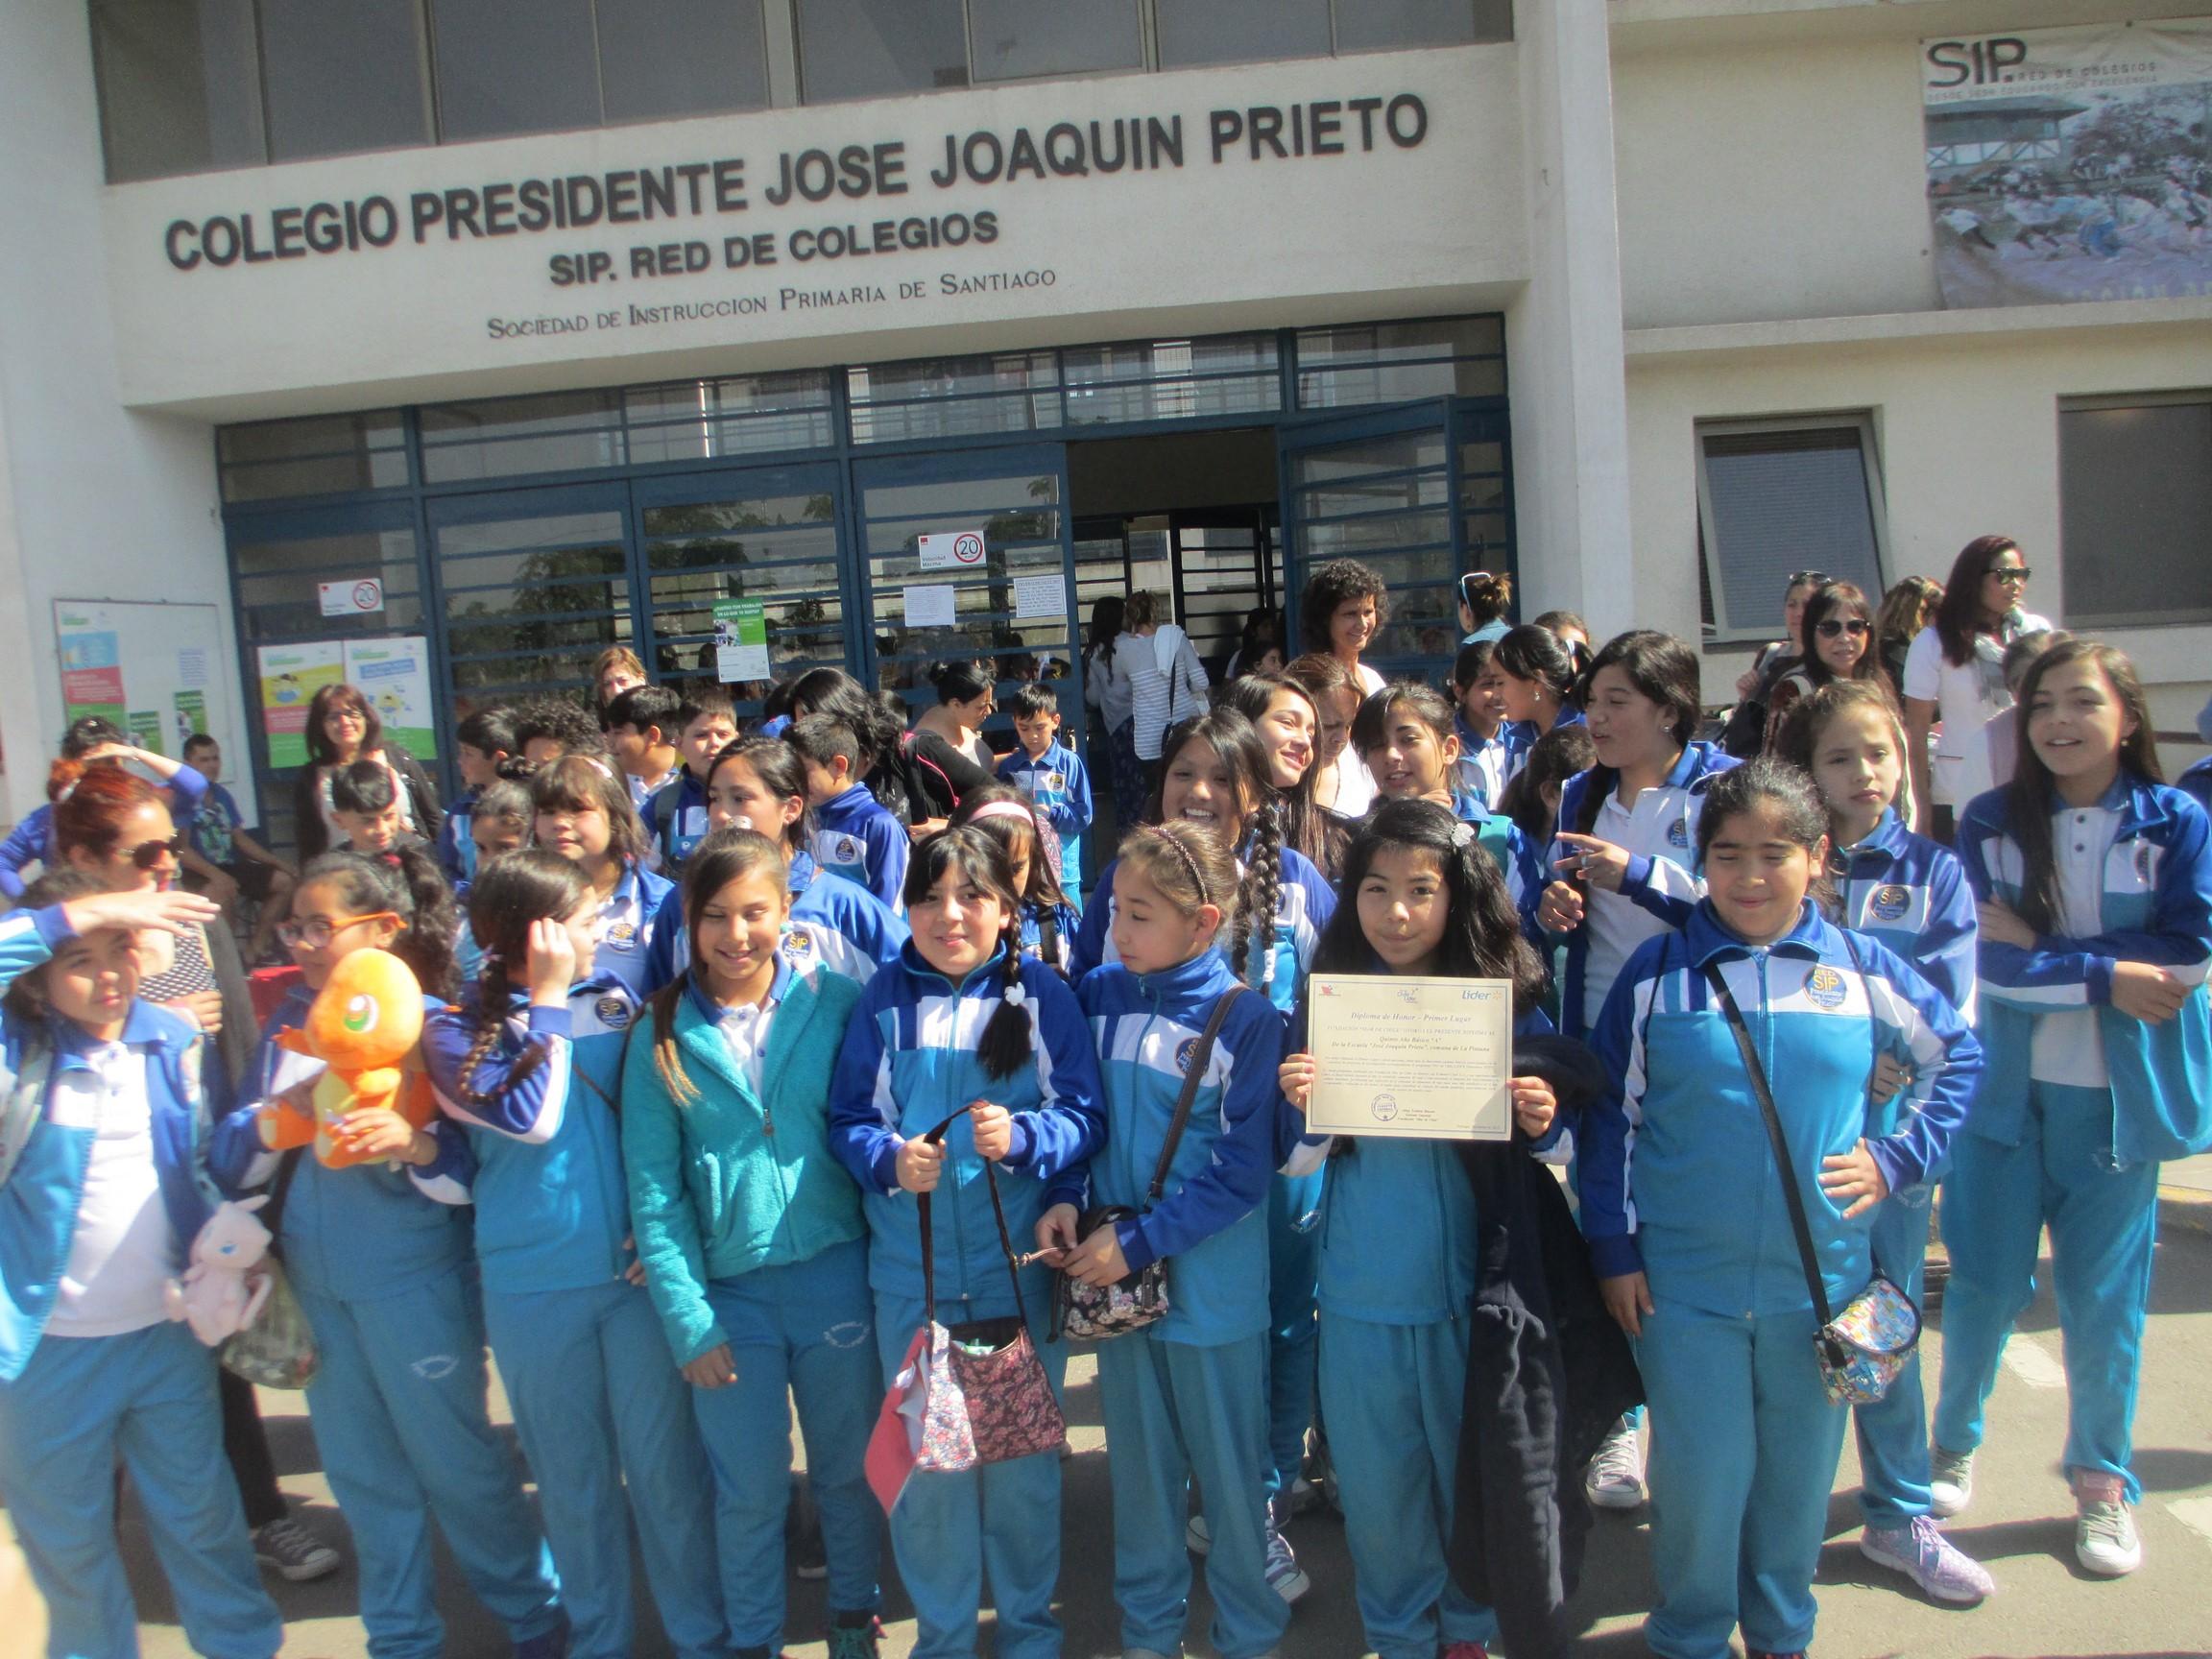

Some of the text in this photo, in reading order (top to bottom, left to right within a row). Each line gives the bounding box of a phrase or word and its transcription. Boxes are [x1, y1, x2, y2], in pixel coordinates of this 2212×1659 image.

[165, 94, 1428, 271] COLEGIO PRESIDENTE JOSE JOAQUIN PRIETO
[549, 211, 998, 286] SIP. RED DE COLEGIOS
[959, 540, 978, 555] 20
[1813, 974, 1839, 991] SIP
[1351, 1012, 1381, 1021] Diploma
